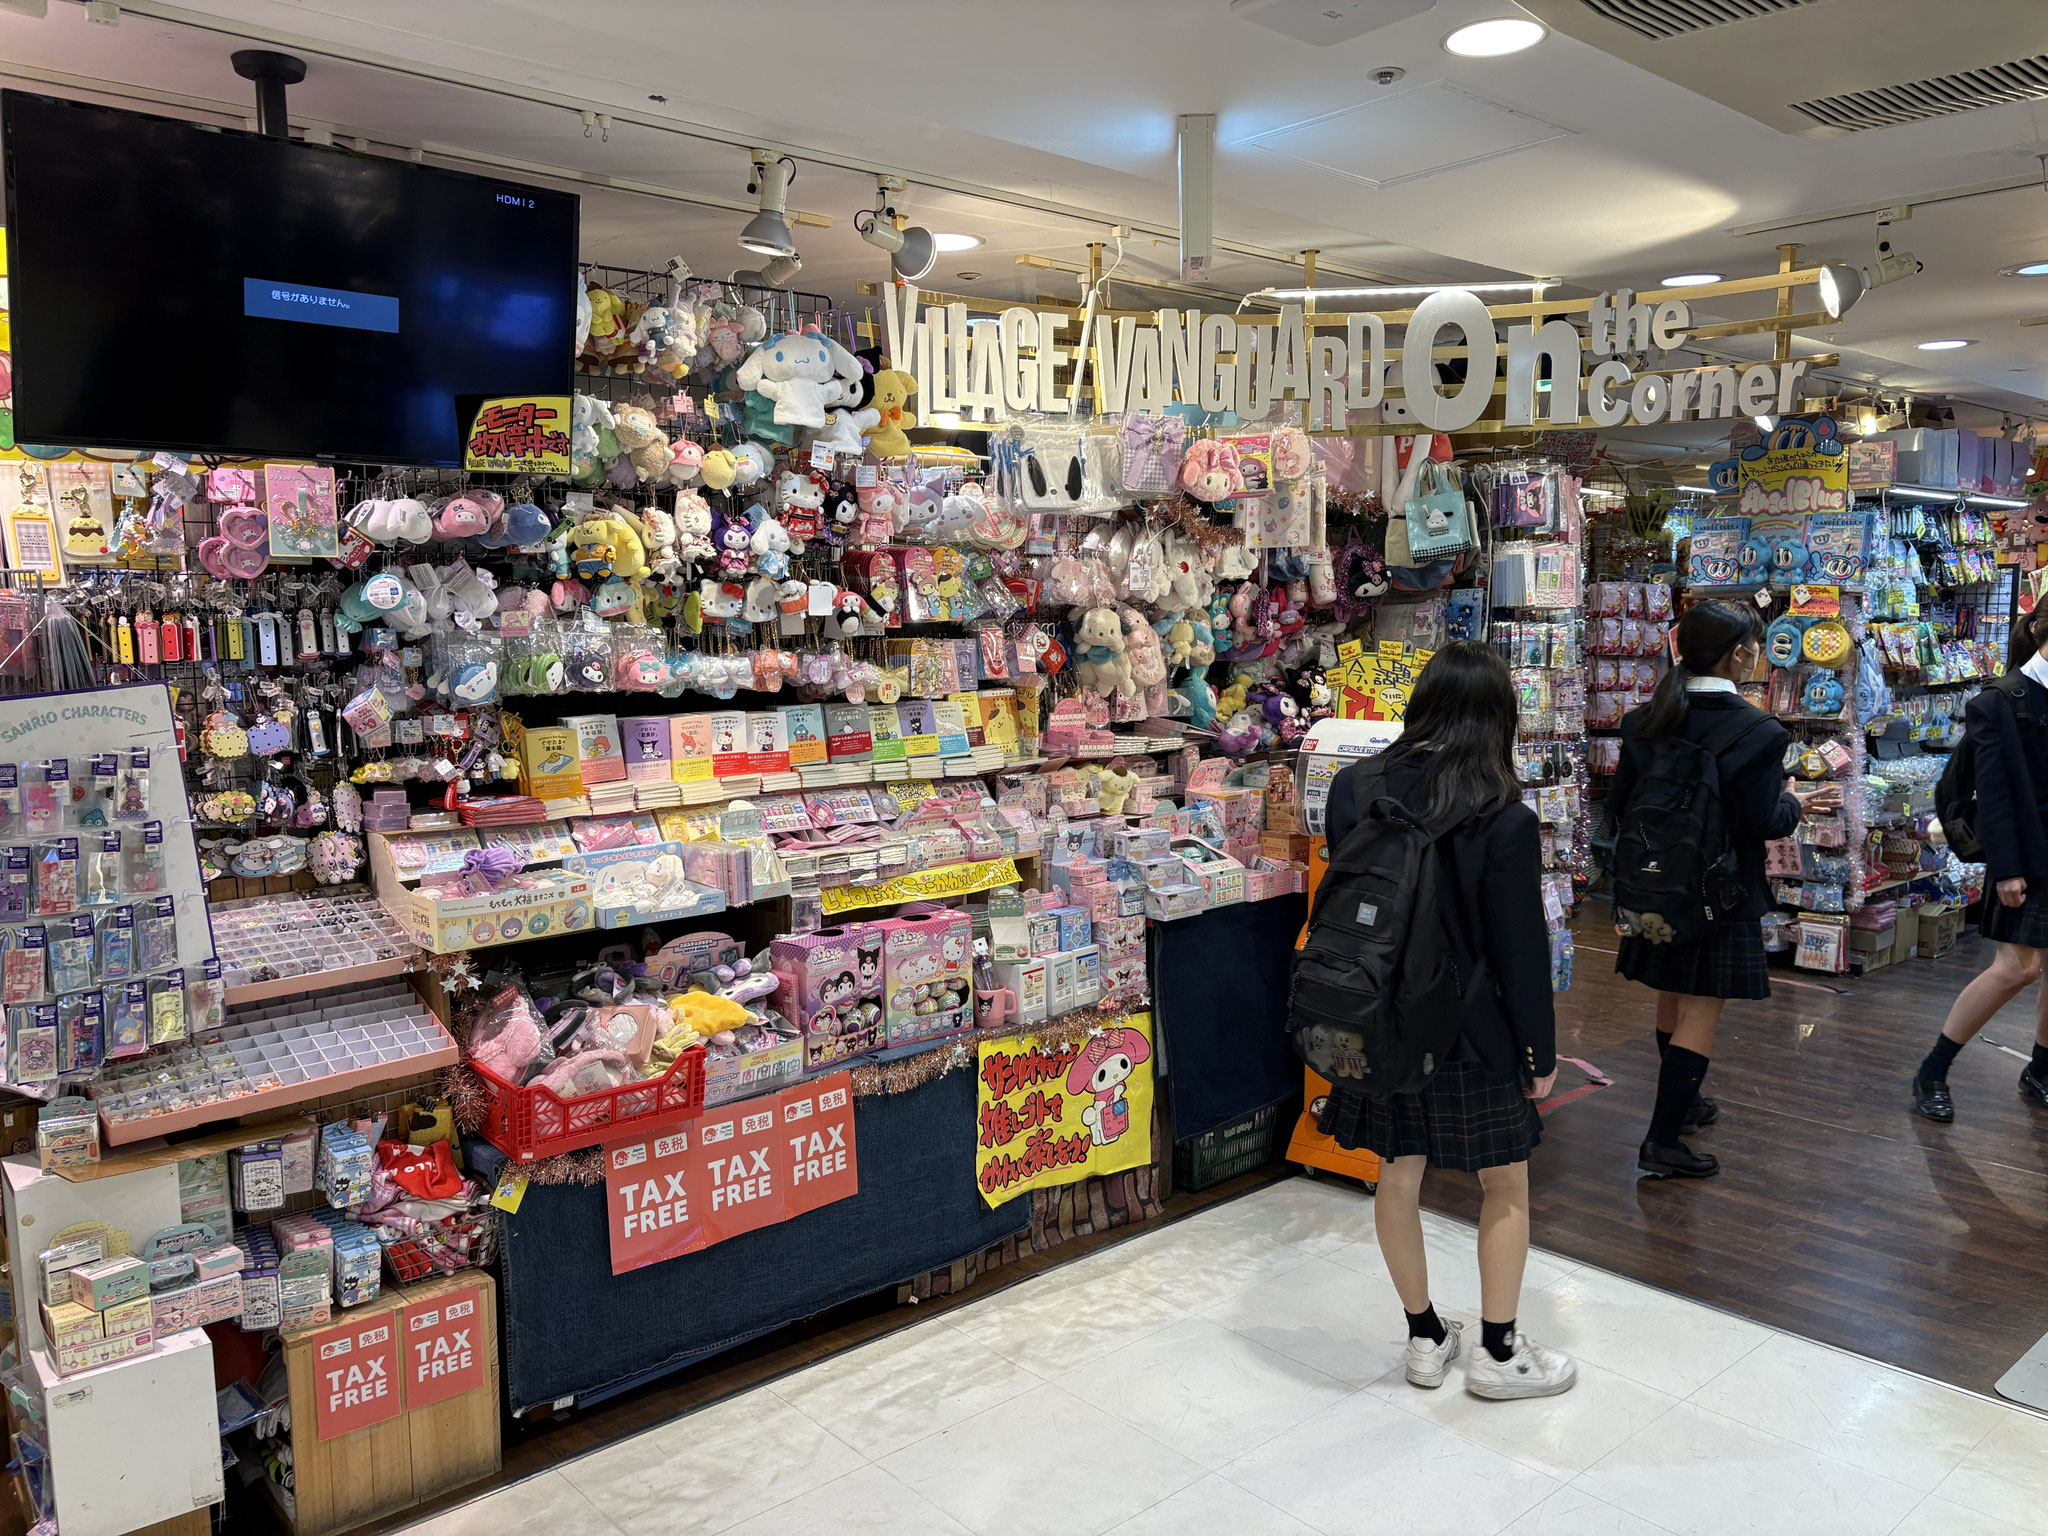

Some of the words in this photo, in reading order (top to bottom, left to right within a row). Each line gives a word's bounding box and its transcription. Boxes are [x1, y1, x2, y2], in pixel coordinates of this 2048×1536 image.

[496, 194, 526, 206] HDMI
[528, 200, 535, 208] 2
[271, 289, 351, 309] 信号がありません。
[1588, 288, 1694, 355] the
[876, 281, 1070, 427] VILLAGE
[1096, 304, 1385, 432] VANGUARD
[1403, 290, 1581, 431] On
[1588, 360, 1812, 426] Corner
[477, 403, 557, 429] モニター
[469, 423, 570, 458] 故障中です
[0, 711, 58, 743] SANRIO
[61, 705, 148, 726] CHARACTERS
[822, 1092, 844, 1110] 免税
[979, 1090, 1064, 1148] 推しゴトを
[745, 1114, 769, 1133] 免税
[658, 1137, 685, 1156] 免税
[790, 1123, 846, 1162] TAX
[979, 1128, 1092, 1193] かわいく楽しもう!
[708, 1147, 770, 1186] TAX
[793, 1150, 847, 1186] FREE
[619, 1170, 687, 1213] TAX
[712, 1174, 772, 1212] FREE
[624, 1199, 689, 1239] FREE
[448, 1304, 471, 1319] 免税
[362, 1329, 385, 1346] 免税
[415, 1328, 472, 1363] TAX
[326, 1355, 387, 1393] TAX
[418, 1350, 473, 1383] FREE
[329, 1378, 388, 1413] FREE
